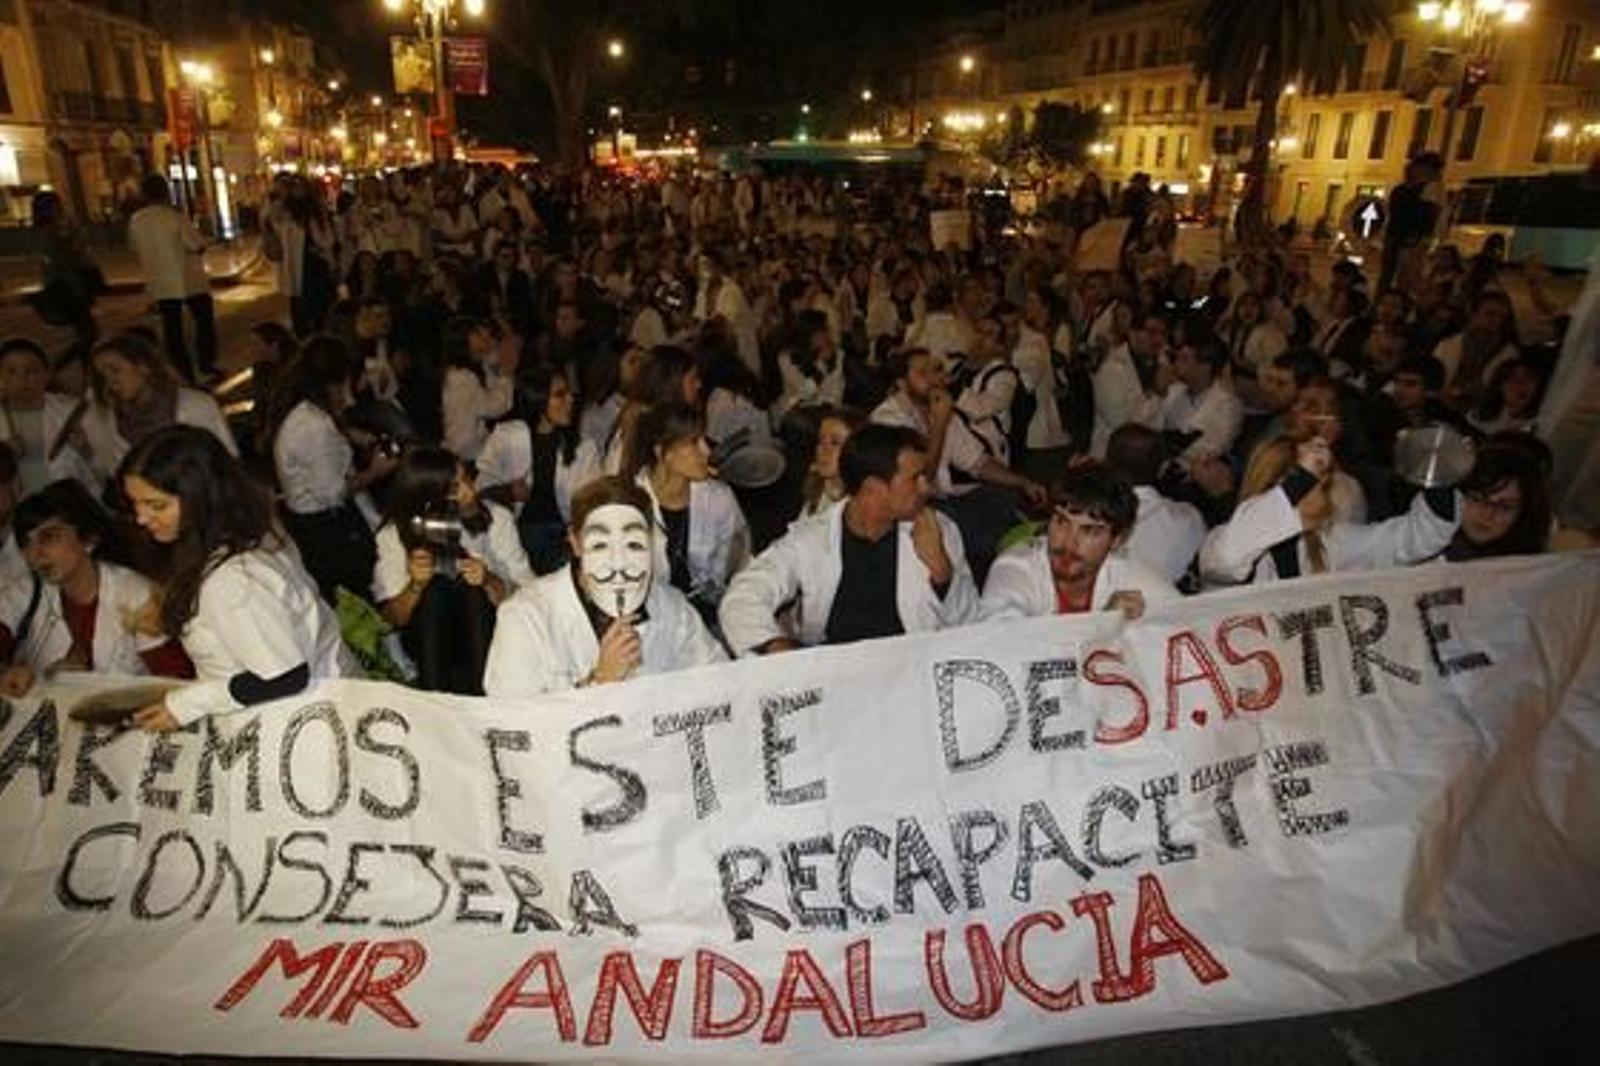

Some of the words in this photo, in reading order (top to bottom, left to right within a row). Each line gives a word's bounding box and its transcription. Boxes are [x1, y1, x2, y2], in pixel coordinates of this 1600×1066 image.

[54, 822, 638, 938] CONSEJERA
[717, 741, 1350, 941] RECAPACITE
[485, 688, 827, 853] ESTE
[214, 938, 428, 1030] MIR
[467, 872, 1230, 1047] ANDALUCIA
